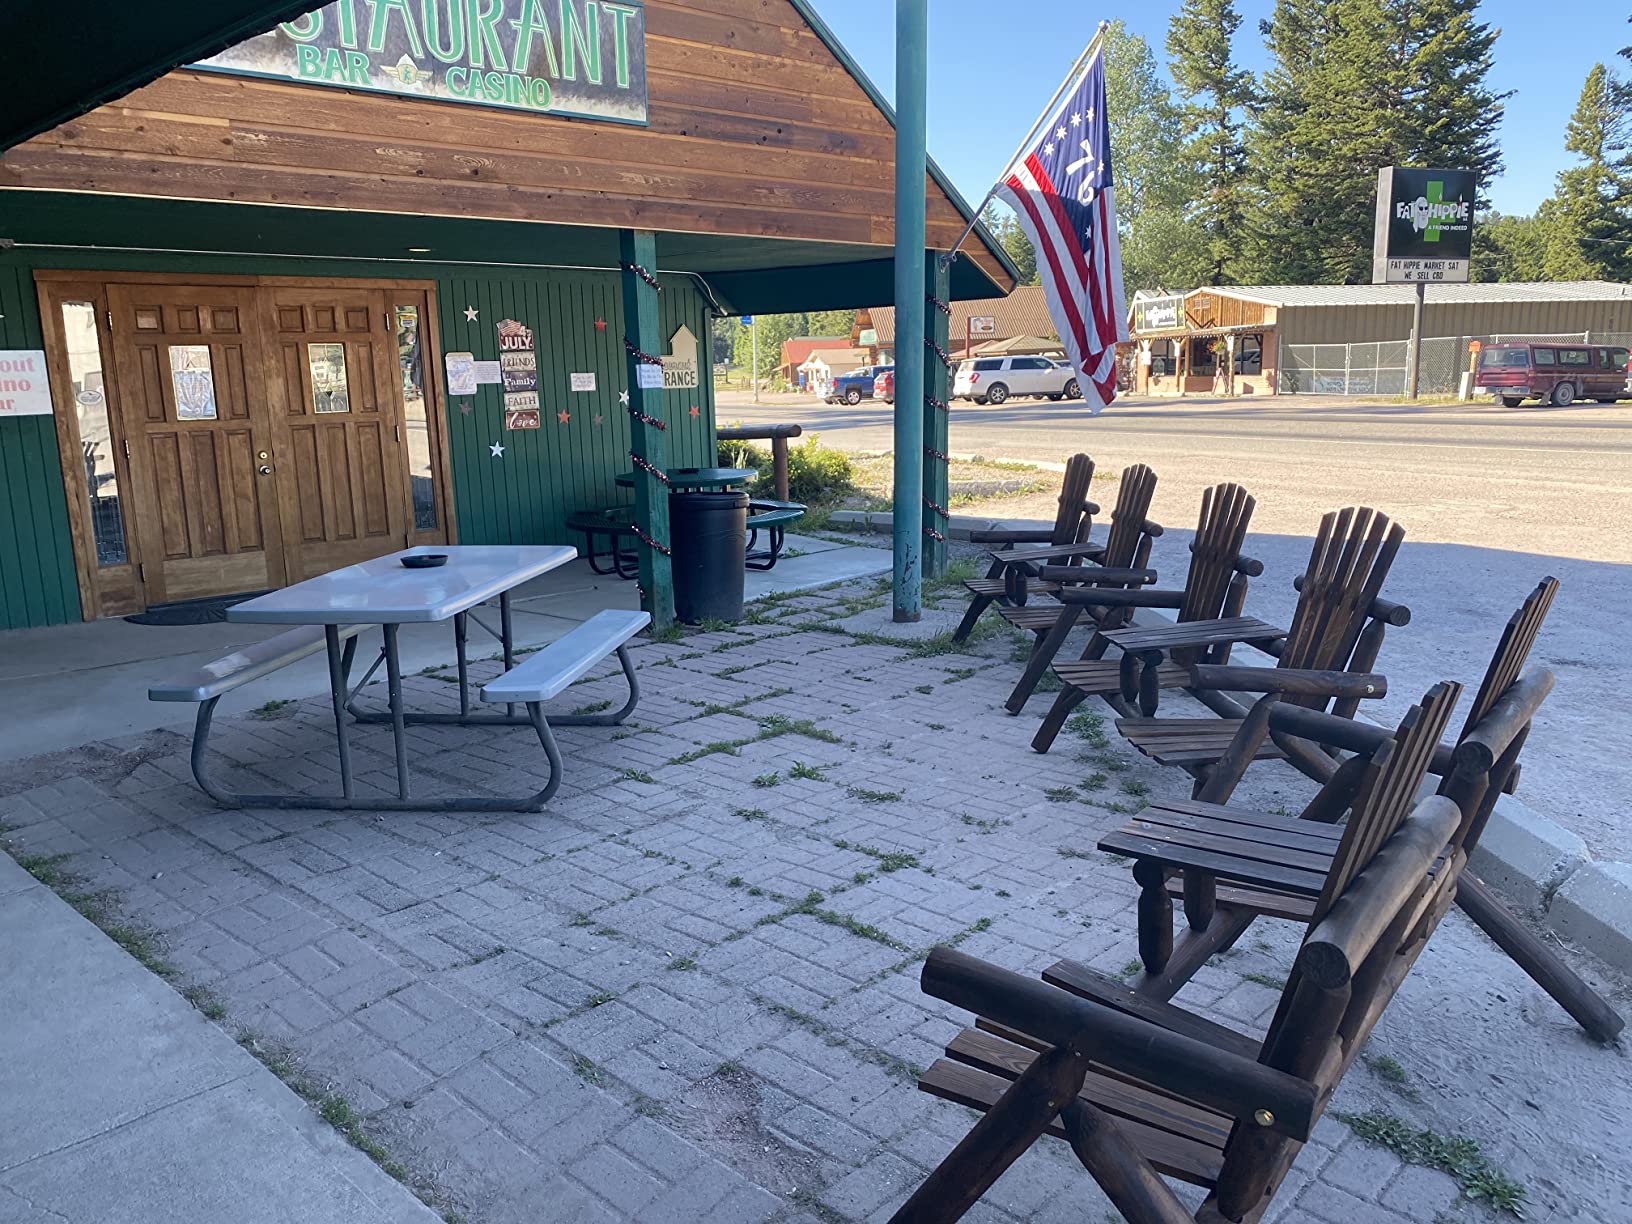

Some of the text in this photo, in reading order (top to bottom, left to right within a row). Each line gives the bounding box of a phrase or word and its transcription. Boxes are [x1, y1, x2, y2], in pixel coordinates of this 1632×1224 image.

[296, 44, 372, 85] BAR
[446, 67, 551, 107] CASINO
[1066, 139, 1095, 206] 76
[1391, 261, 1459, 270] FAT HIPPIE MARKET SAT
[1405, 272, 1444, 280] WE SELL CBD
[502, 336, 532, 349] JULY
[0, 357, 35, 372] out
[503, 357, 535, 367] FRIENDS
[504, 378, 536, 387] Family
[664, 371, 696, 386] RANCE
[0, 379, 31, 392] no
[508, 396, 536, 406] FAITH
